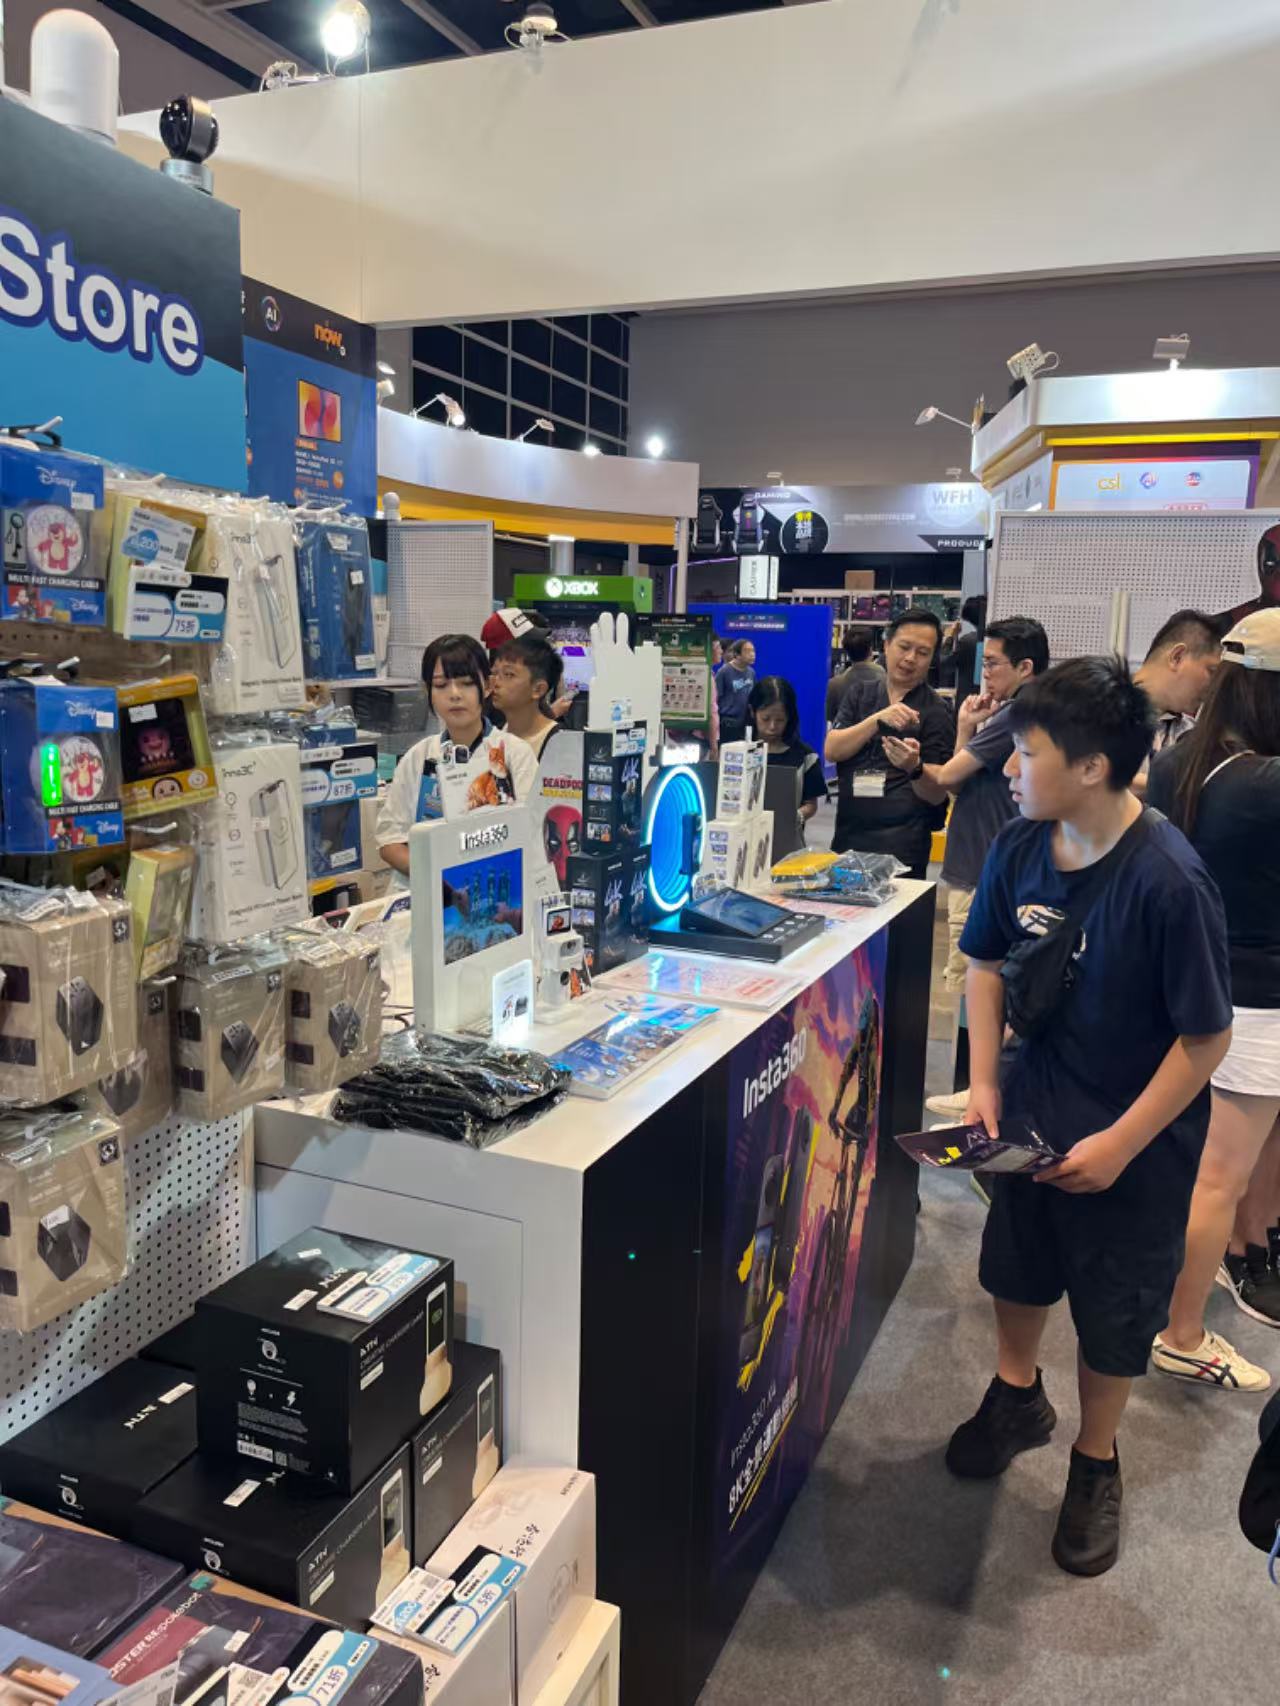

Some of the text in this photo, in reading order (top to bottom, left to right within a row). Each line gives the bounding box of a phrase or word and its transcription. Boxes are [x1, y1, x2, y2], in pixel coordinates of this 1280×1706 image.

[0, 215, 199, 367] Store
[314, 323, 343, 347] now
[36, 466, 76, 488] Disney
[1098, 472, 1120, 490] csl
[933, 489, 972, 504] WFH
[563, 580, 599, 595] XBOX
[461, 823, 509, 851] Insta360
[743, 1027, 807, 1119] Insta360
